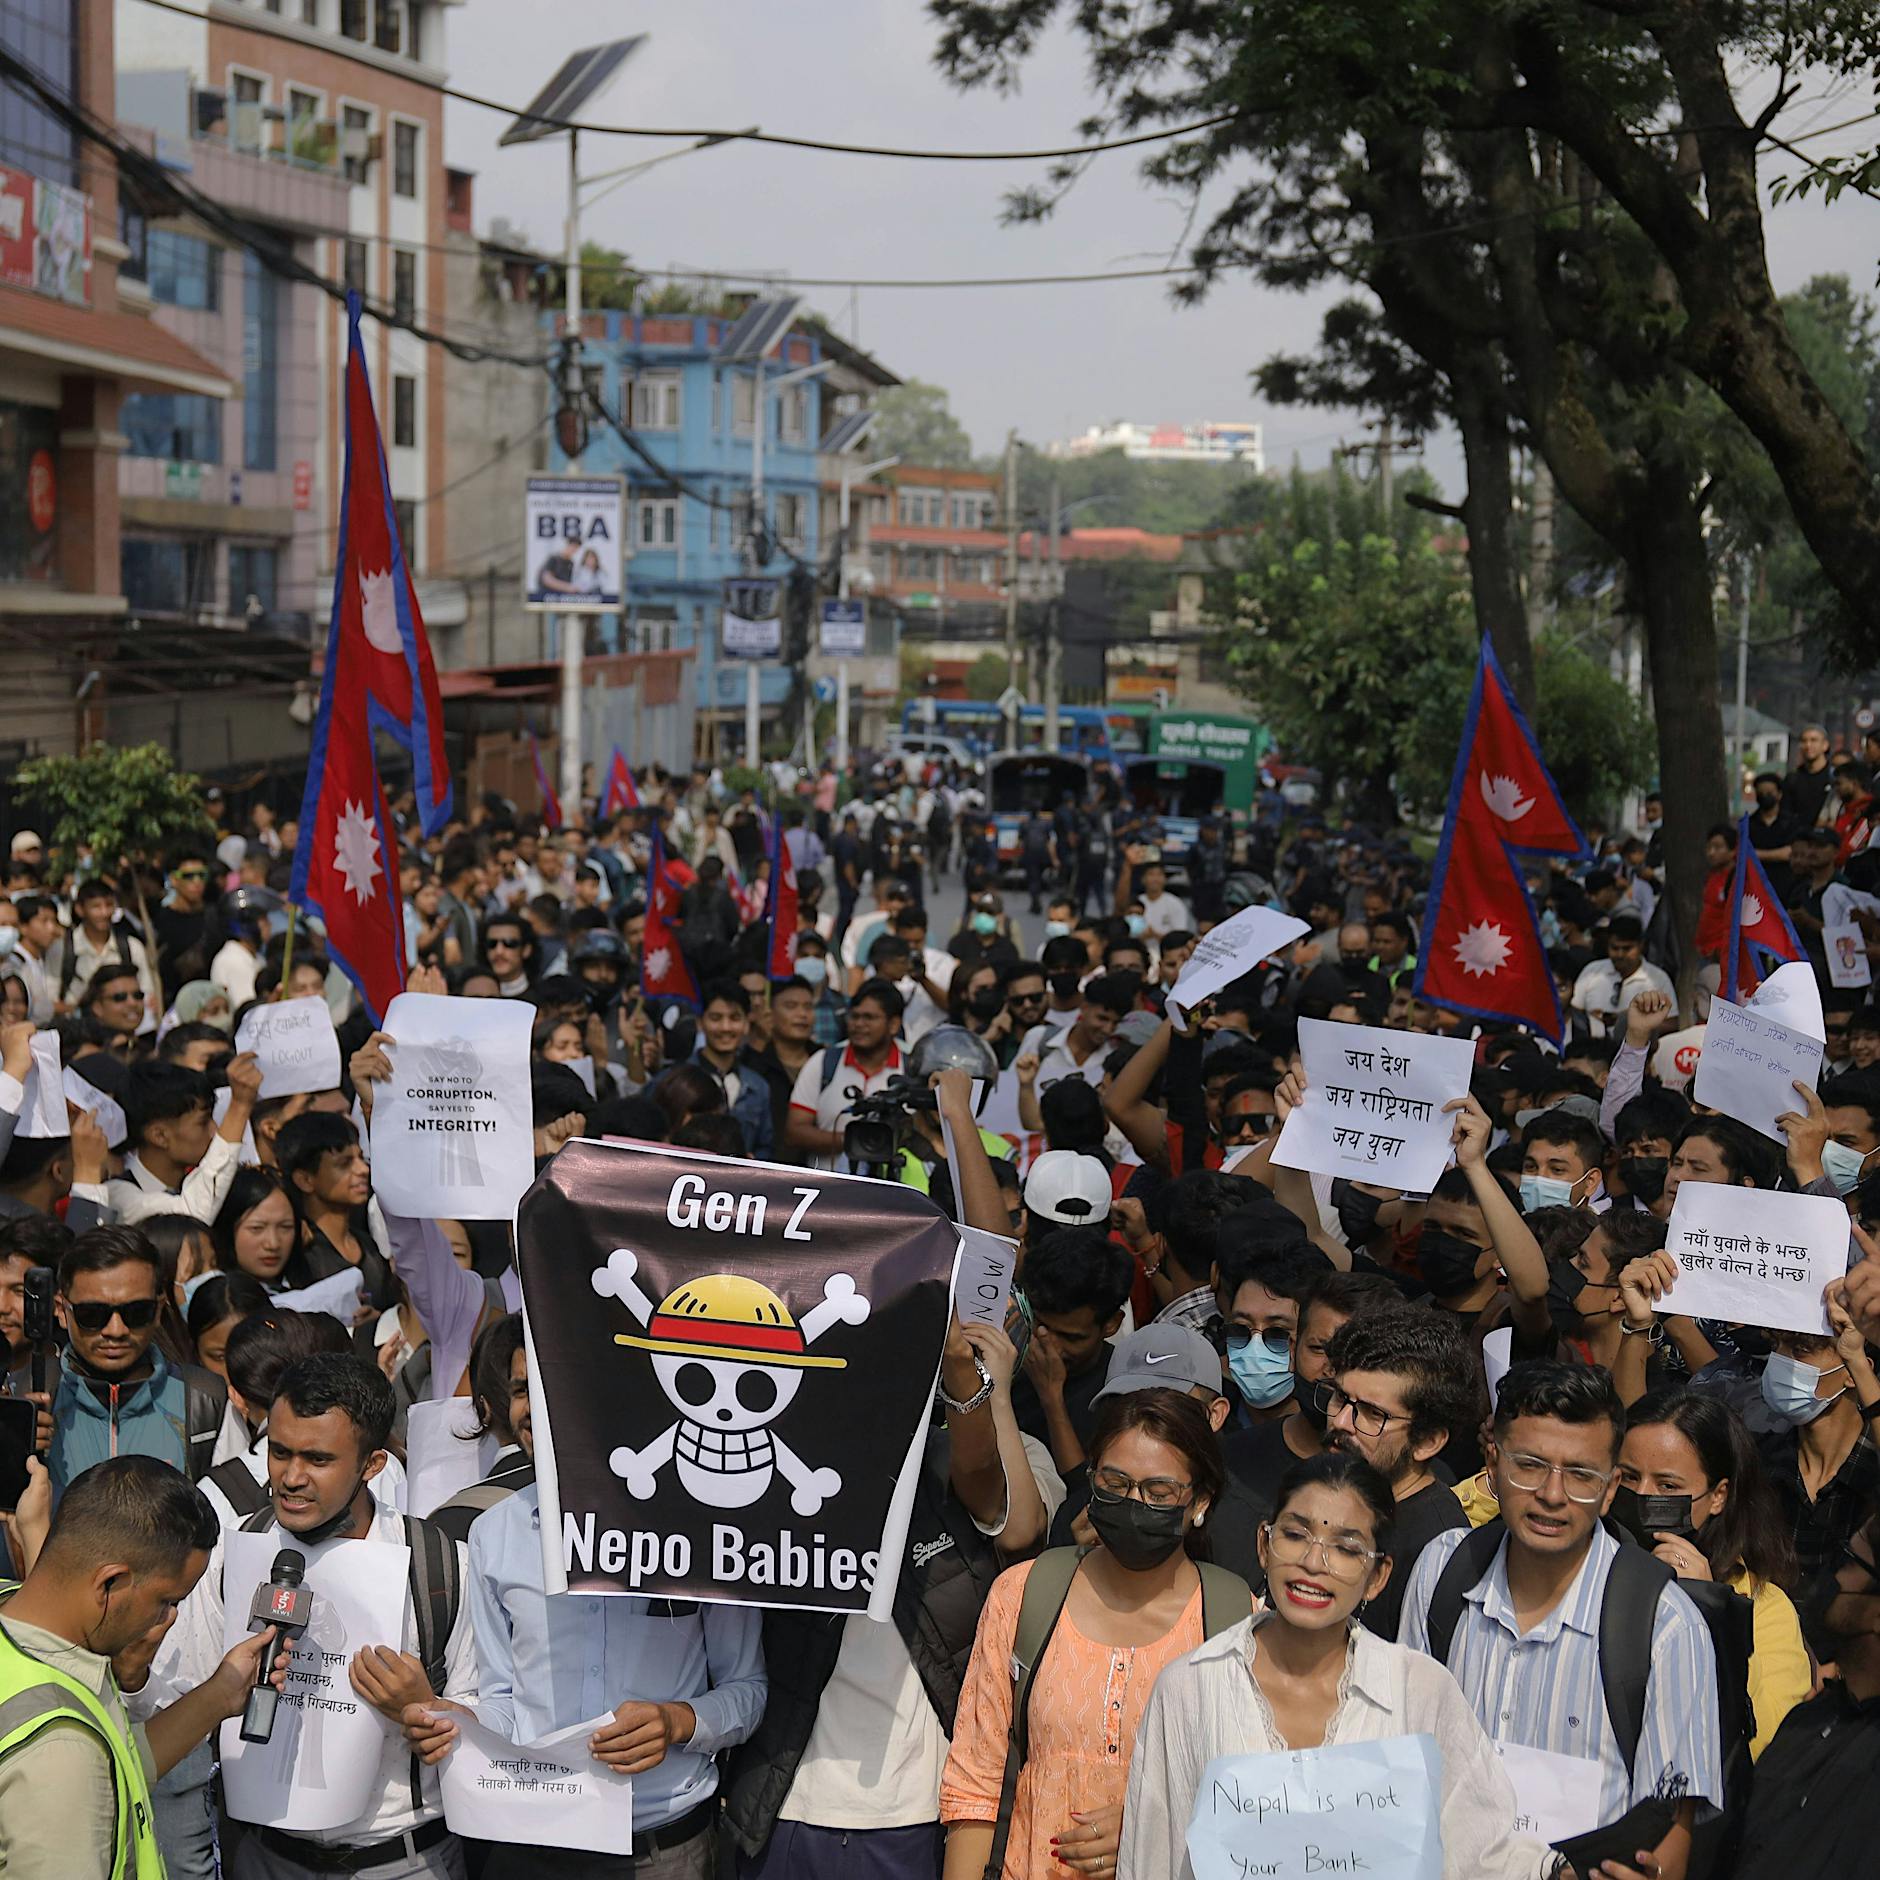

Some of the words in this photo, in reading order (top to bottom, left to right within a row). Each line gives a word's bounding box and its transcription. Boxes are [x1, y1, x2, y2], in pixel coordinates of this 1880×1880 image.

[537, 515, 610, 540] BBA
[1344, 1049, 1375, 1072] जय
[1380, 1046, 1411, 1078] देश
[447, 1076, 459, 1084] NO
[406, 1089, 497, 1101] CORRUPTION,
[447, 1105, 462, 1113] YES
[465, 1105, 475, 1113] TO
[1325, 1085, 1355, 1109] जय
[1360, 1087, 1434, 1123] राष्ट्रियता
[408, 1119, 497, 1132] INTEGRITY!
[1333, 1126, 1365, 1150] जय
[1367, 1133, 1406, 1161] युवा
[666, 1174, 768, 1236] Gen
[783, 1187, 821, 1242] Z
[1683, 1228, 1710, 1248] नयाँ
[1713, 1234, 1752, 1254] युवाले
[1755, 1236, 1771, 1254] के
[1775, 1243, 1811, 1264] भन्छ,
[1679, 1250, 1715, 1272] खुलेर
[1718, 1254, 1754, 1276] बोल्न
[1757, 1258, 1769, 1279] दे
[969, 1255, 1005, 1322] NOW
[562, 1511, 691, 1588] Nepo
[712, 1522, 879, 1593] Babies
[321, 1651, 347, 1667] पुस्ता
[307, 1693, 358, 1714] गिज्याउन्छ
[488, 1758, 531, 1774] असन्तुष्टि
[534, 1761, 558, 1773] चरम
[560, 1766, 573, 1775] छ,
[477, 1774, 511, 1790] नेताको
[514, 1776, 538, 1792] गोजी
[541, 1782, 564, 1793] गरम
[567, 1784, 583, 1795] छ।
[1213, 1778, 1290, 1825] Nepal
[1315, 1788, 1336, 1813] is
[1355, 1784, 1401, 1812] not
[1304, 1844, 1372, 1874] Bank
